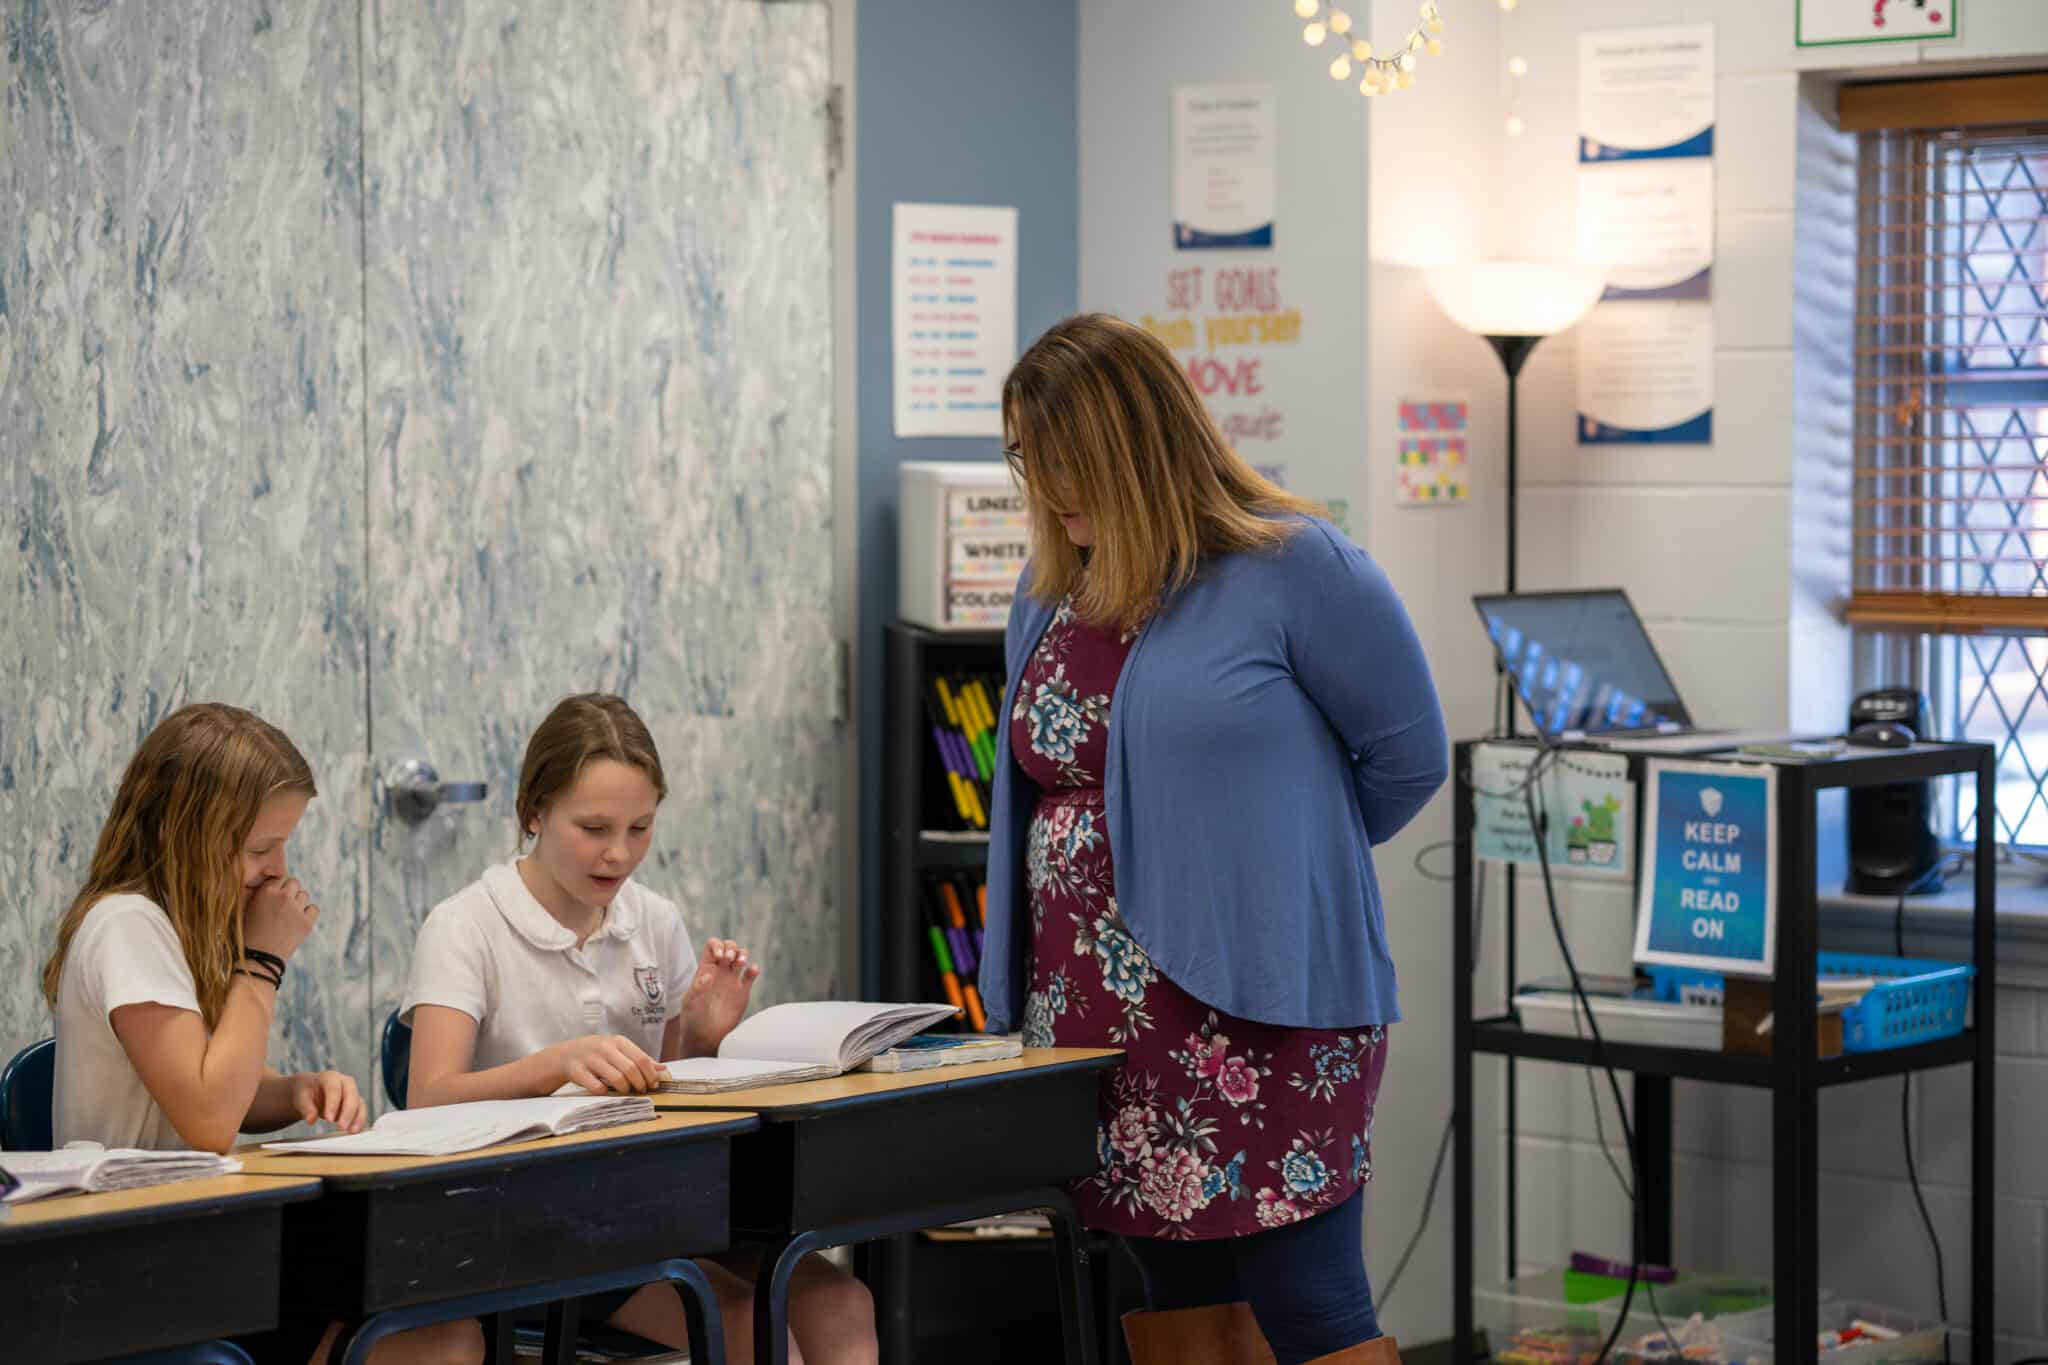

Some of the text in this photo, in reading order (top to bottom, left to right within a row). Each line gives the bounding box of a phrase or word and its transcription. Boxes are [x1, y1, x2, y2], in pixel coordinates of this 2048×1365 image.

[1167, 266, 1280, 312] SET GOALS
[966, 496, 1025, 513] LINED
[1684, 821, 1741, 845] KEEP
[1682, 848, 1742, 874] CALM
[1680, 887, 1740, 913] READ
[1691, 916, 1725, 940] ON
